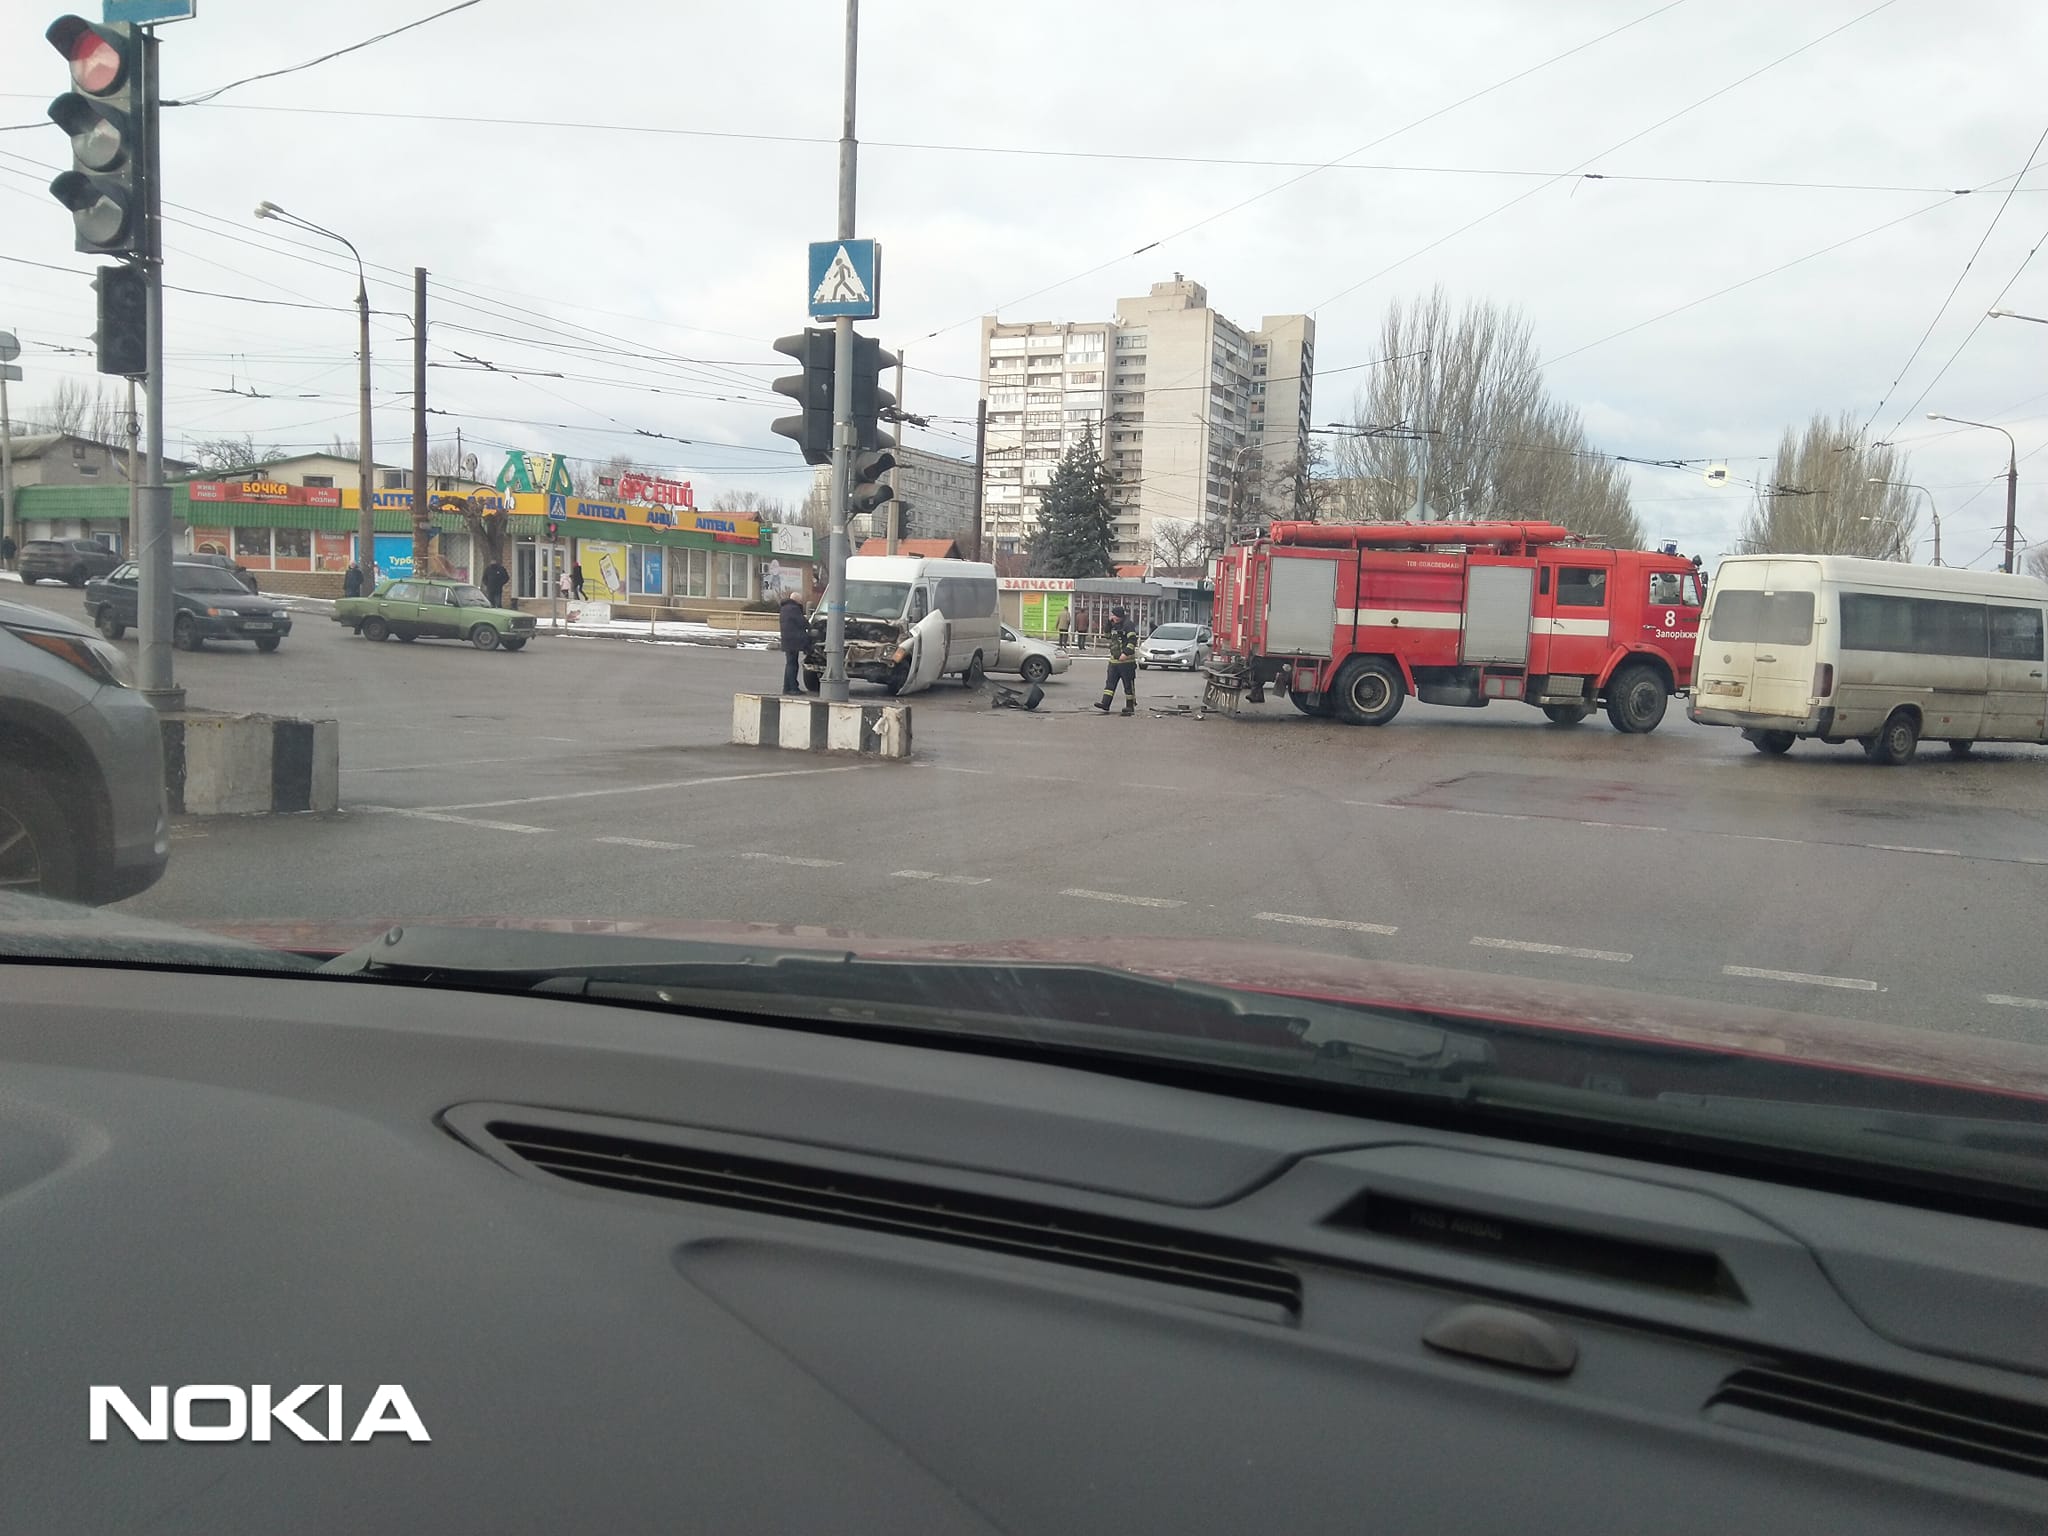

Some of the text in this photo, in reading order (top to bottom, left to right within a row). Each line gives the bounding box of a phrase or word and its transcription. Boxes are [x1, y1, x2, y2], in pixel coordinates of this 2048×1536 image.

[242, 482, 287, 495] БОЧКА
[372, 493, 439, 506] АПТЕА
[577, 503, 735, 533] АПТЕКА АНЦ АПТЕКА
[1004, 580, 1075, 590] ЗАПЧАСТИ
[1665, 610, 1676, 627] 8
[1450, 1217, 1503, 1241] AIRBAG
